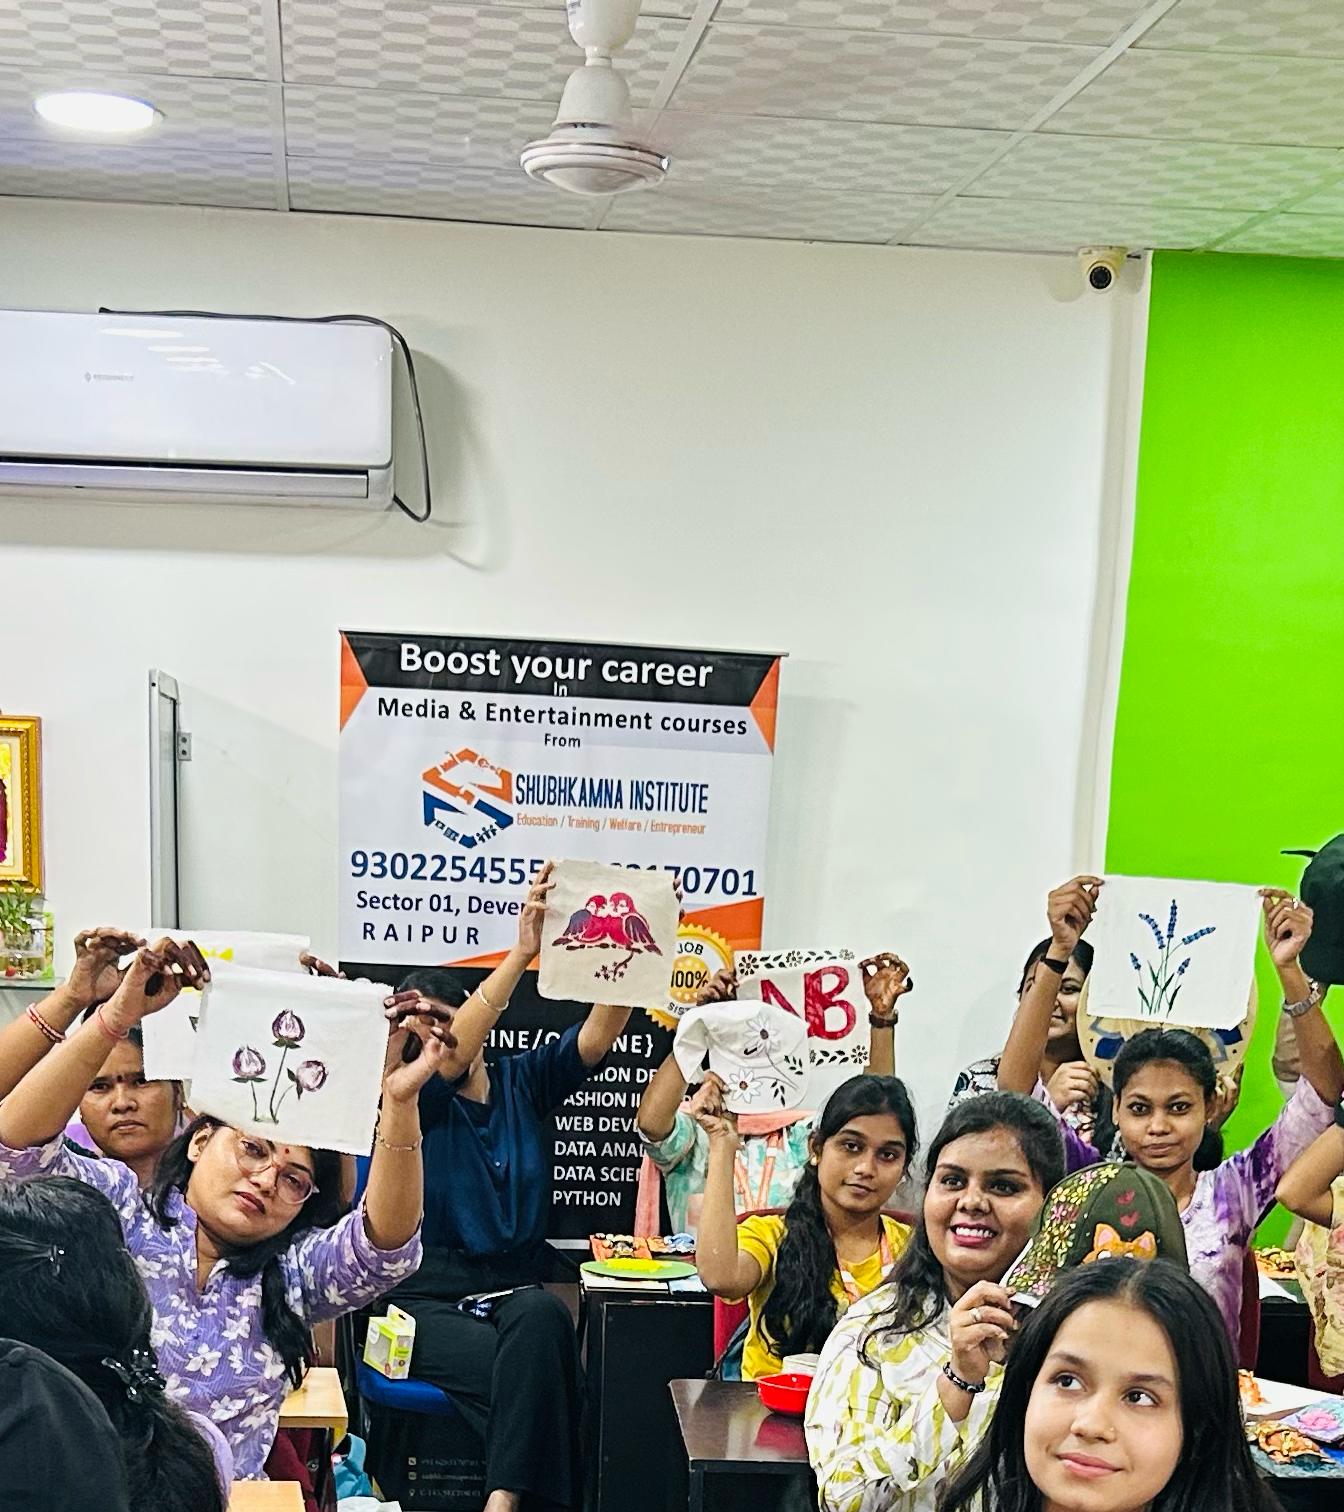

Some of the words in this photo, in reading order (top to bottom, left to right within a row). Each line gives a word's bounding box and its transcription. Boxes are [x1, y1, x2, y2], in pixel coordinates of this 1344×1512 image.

[399, 642, 501, 677] Boost
[511, 654, 592, 684] your
[602, 658, 714, 687] career
[553, 681, 568, 697] In
[377, 698, 450, 720] Media
[459, 701, 476, 721] &
[486, 703, 653, 730] Entertainment
[661, 714, 748, 735] courses
[544, 733, 582, 749] From
[515, 774, 625, 810] SHUBHKAMNA
[631, 780, 710, 814] INSTITUTE
[516, 813, 558, 827] Education
[568, 816, 601, 832] Training
[609, 818, 642, 832] Welfare
[650, 820, 707, 835] Entrepreneur
[356, 890, 425, 912] Sector
[429, 894, 461, 917] 01,
[677, 942, 704, 955] JOB
[670, 969, 709, 989] 100%
[555, 1116, 594, 1132] WEB
[554, 1141, 597, 1157] DATA
[553, 1165, 596, 1182] DATA
[552, 1190, 622, 1207] PYTHON
